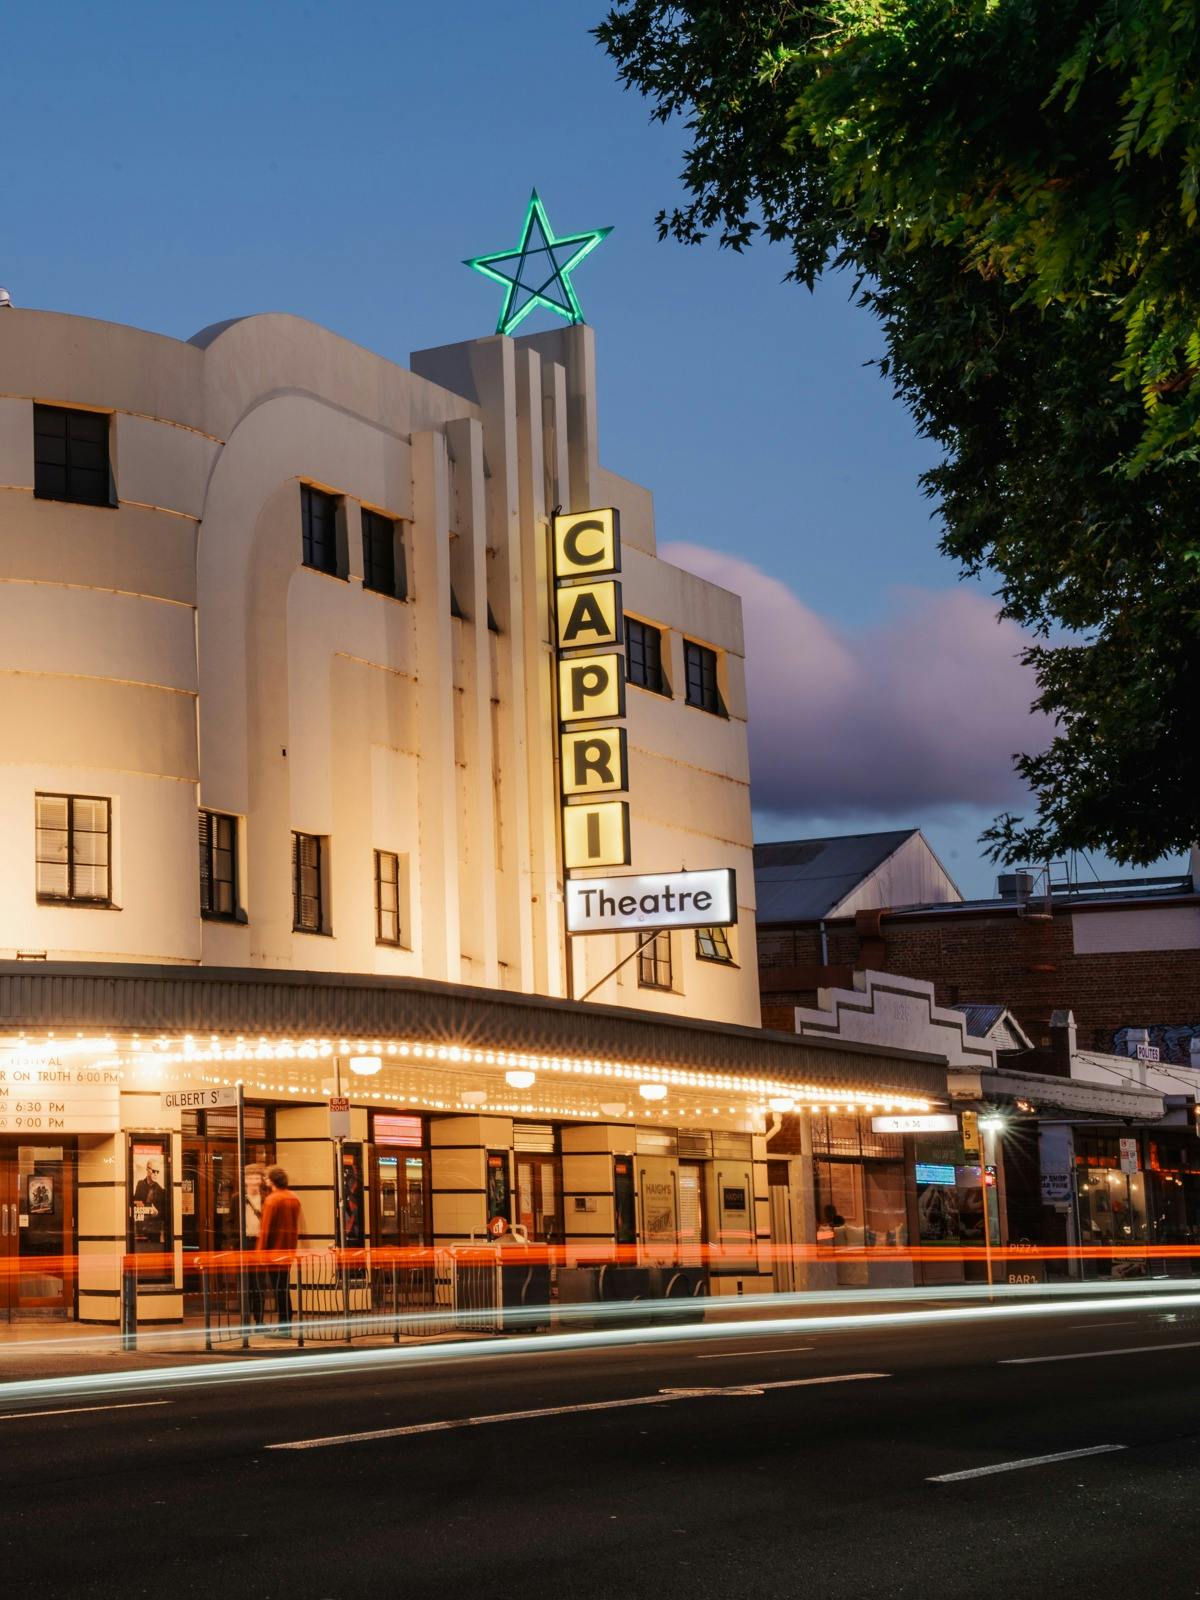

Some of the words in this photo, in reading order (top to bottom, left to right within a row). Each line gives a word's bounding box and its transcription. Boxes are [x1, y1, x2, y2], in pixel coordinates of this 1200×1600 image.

[563, 519, 615, 859] CAPRI
[577, 884, 713, 918] Theatre
[1138, 1046, 1159, 1060] POLITES
[13, 1071, 30, 1081] ON
[38, 1071, 71, 1081] TRUTH
[76, 1071, 101, 1082] 6:00
[103, 1072, 118, 1082] PM
[165, 1092, 206, 1108] GILBERT
[15, 1102, 42, 1112] 6:30
[48, 1102, 65, 1112] PM
[15, 1118, 42, 1128] 9:00
[48, 1118, 64, 1128] PM
[645, 1183, 672, 1195] HAIGH'S
[1009, 1243, 1040, 1254] PIZZA
